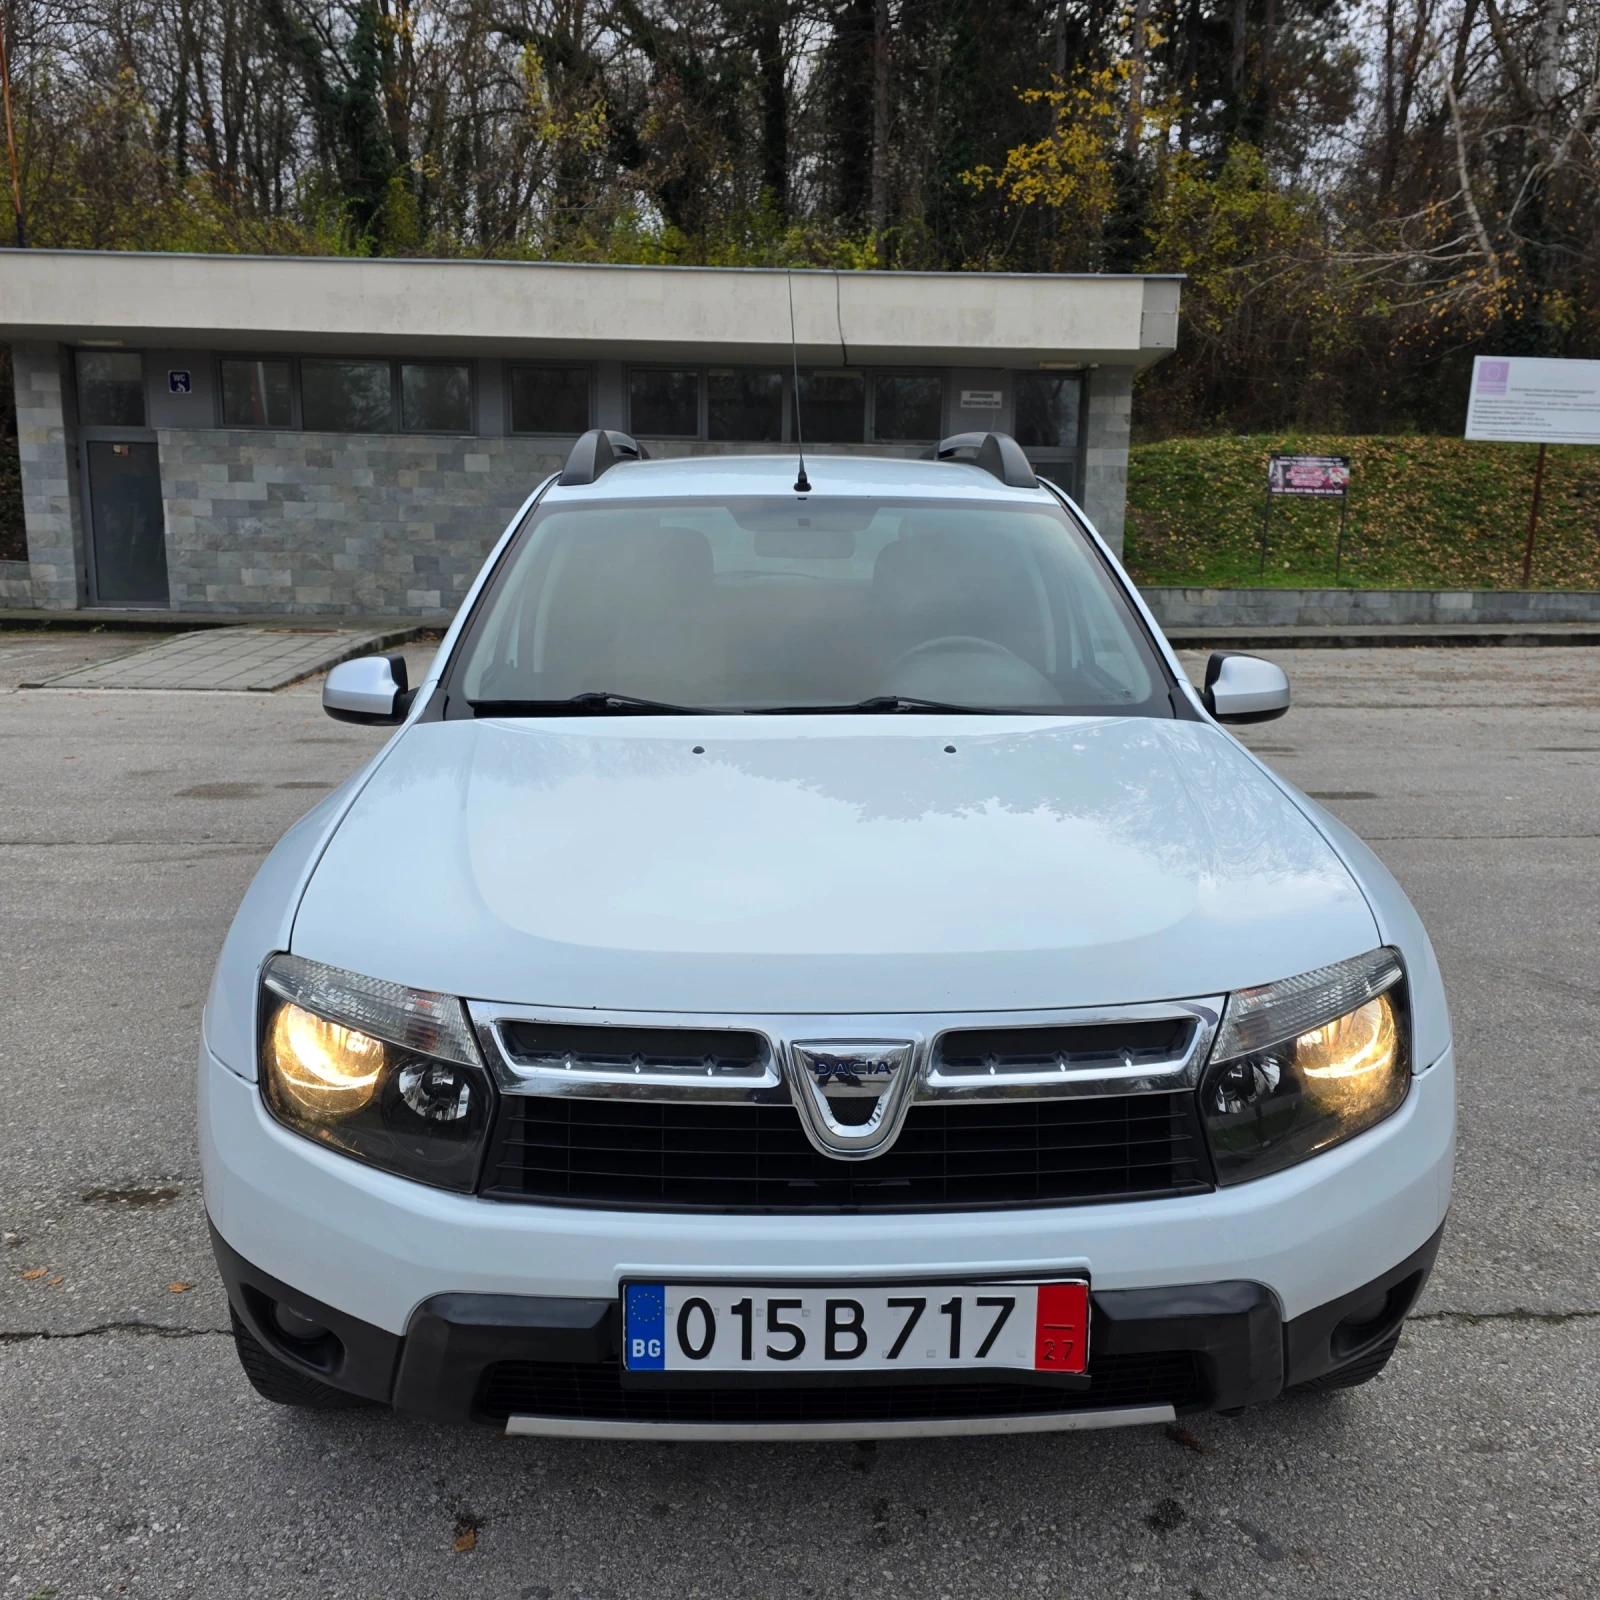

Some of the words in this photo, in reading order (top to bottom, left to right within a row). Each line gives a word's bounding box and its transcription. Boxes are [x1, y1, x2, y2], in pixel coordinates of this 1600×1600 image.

[173, 373, 186, 382] WC
[814, 1061, 892, 1075] DACIA
[632, 1339, 661, 1358] BG
[1043, 1339, 1074, 1361] 27
